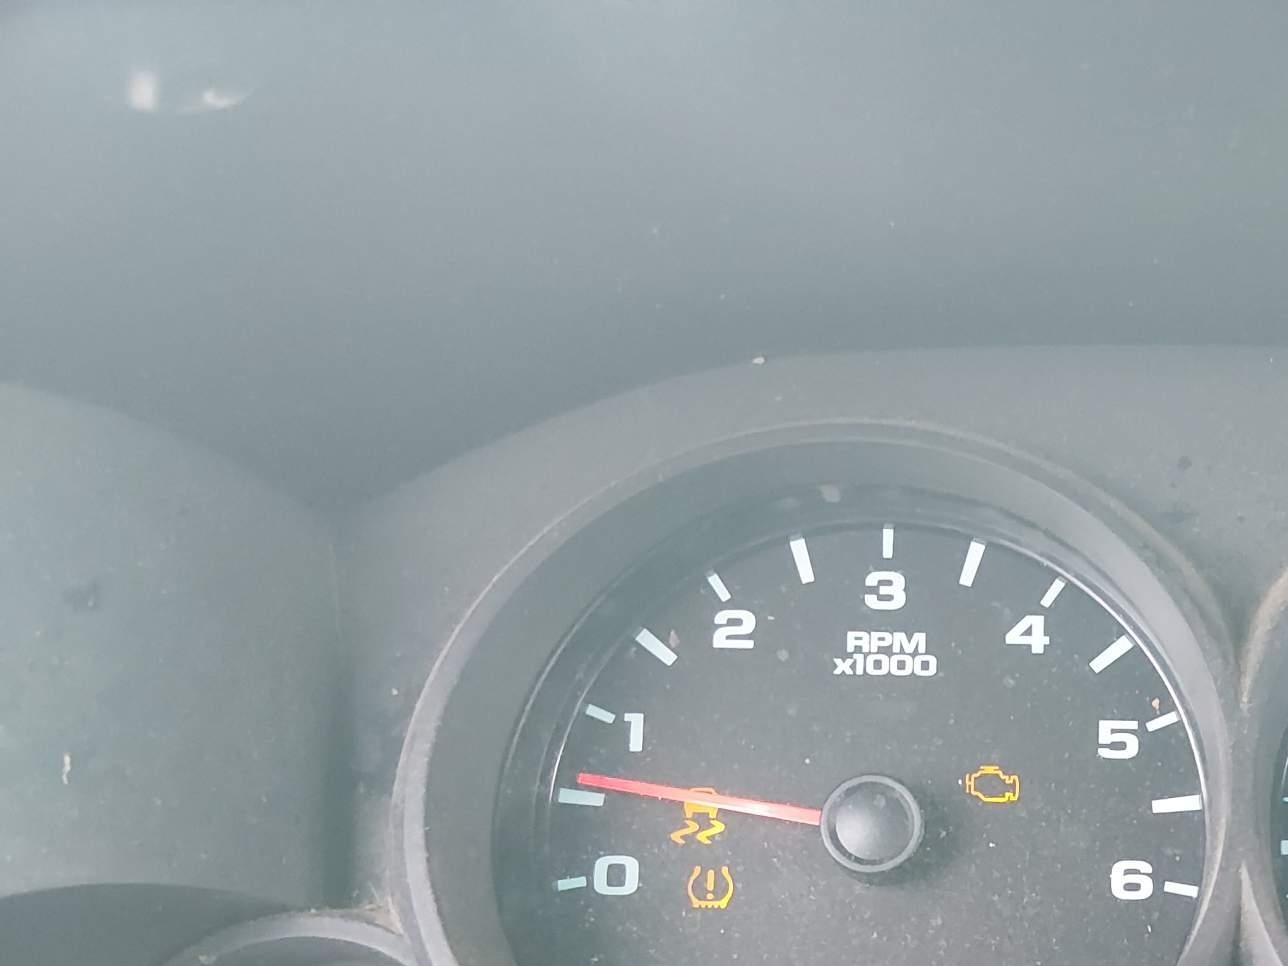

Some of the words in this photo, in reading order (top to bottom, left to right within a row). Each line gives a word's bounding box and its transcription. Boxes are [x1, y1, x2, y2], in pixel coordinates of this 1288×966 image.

[865, 571, 906, 610] 3
[712, 609, 755, 649] 2
[846, 631, 927, 654] RPM
[1005, 614, 1050, 654] 4
[833, 654, 937, 676] x1000
[624, 712, 643, 752] 1
[1097, 720, 1138, 759] 5
[593, 855, 639, 896] 0
[1109, 860, 1154, 900] 6
